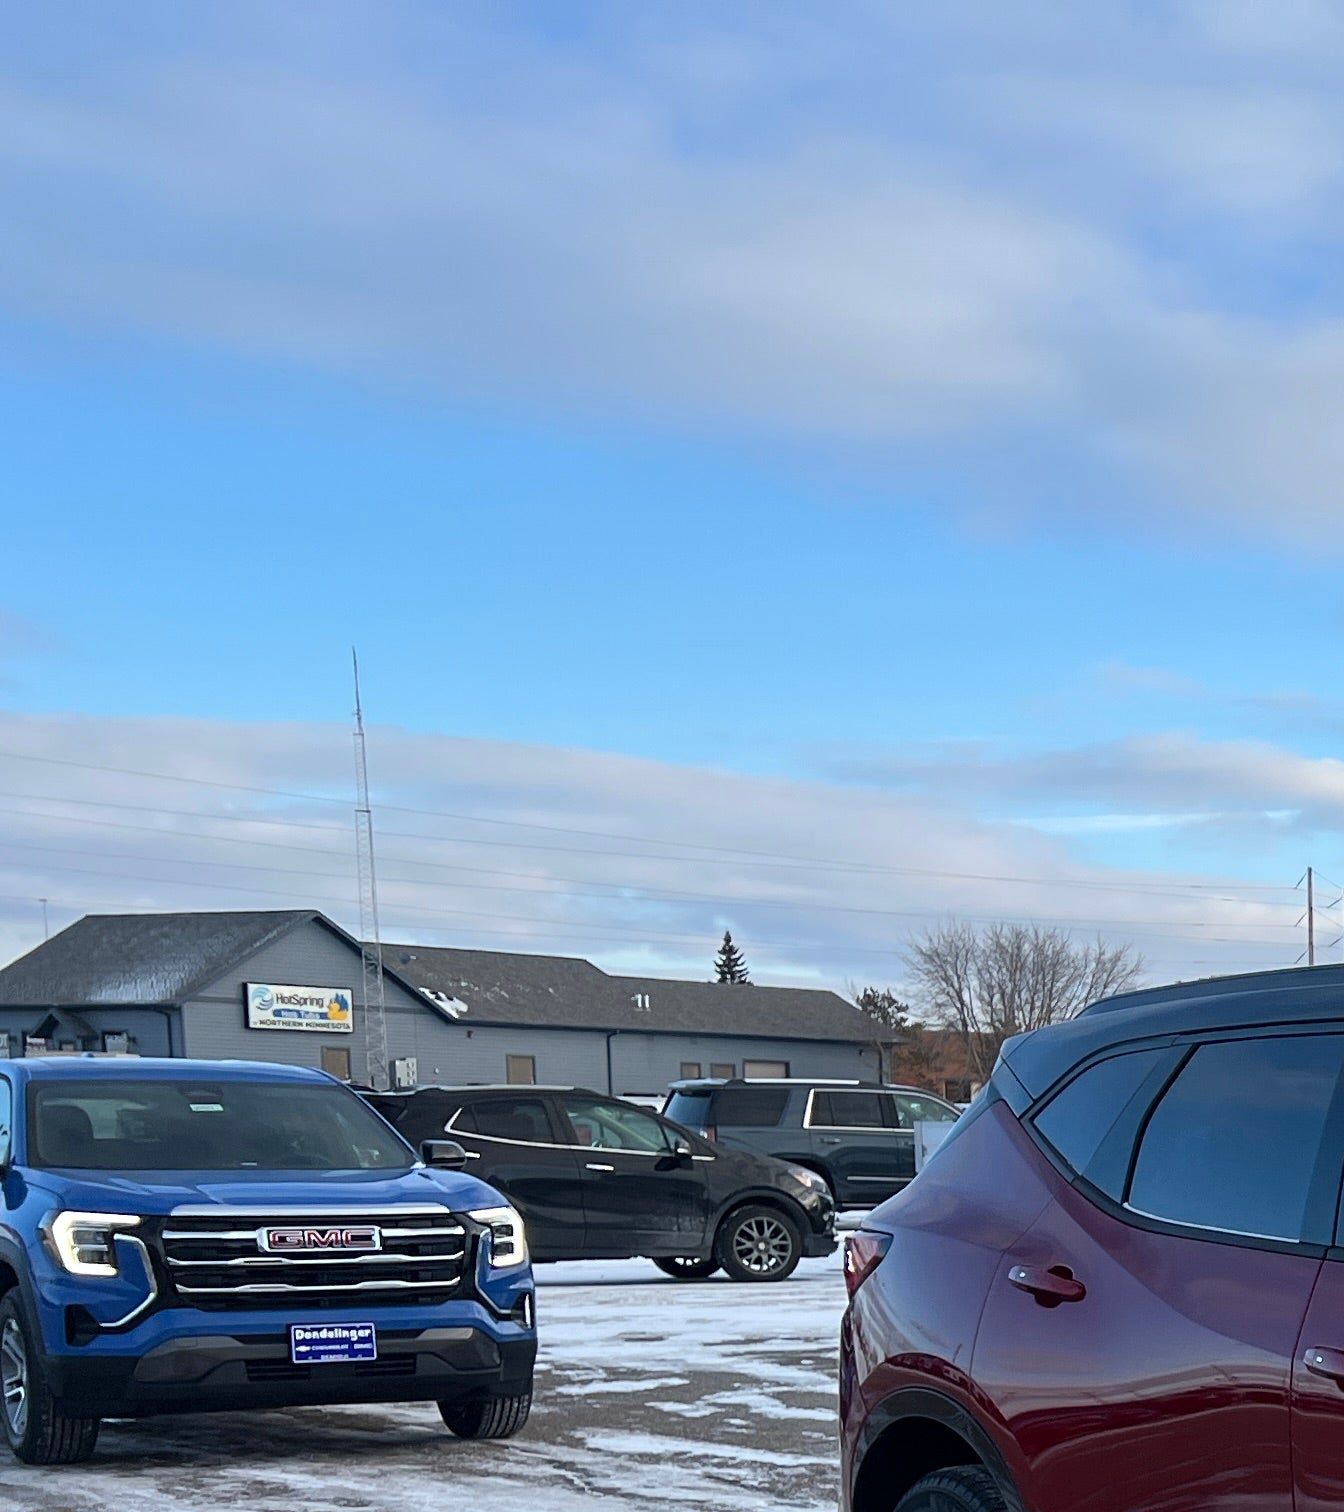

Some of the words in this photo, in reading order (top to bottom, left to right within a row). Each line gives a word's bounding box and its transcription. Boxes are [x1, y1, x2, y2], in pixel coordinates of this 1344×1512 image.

[275, 993, 324, 1008] HotSpring
[269, 1229, 376, 1249] GMC
[295, 1328, 371, 1341] Dondelinger
